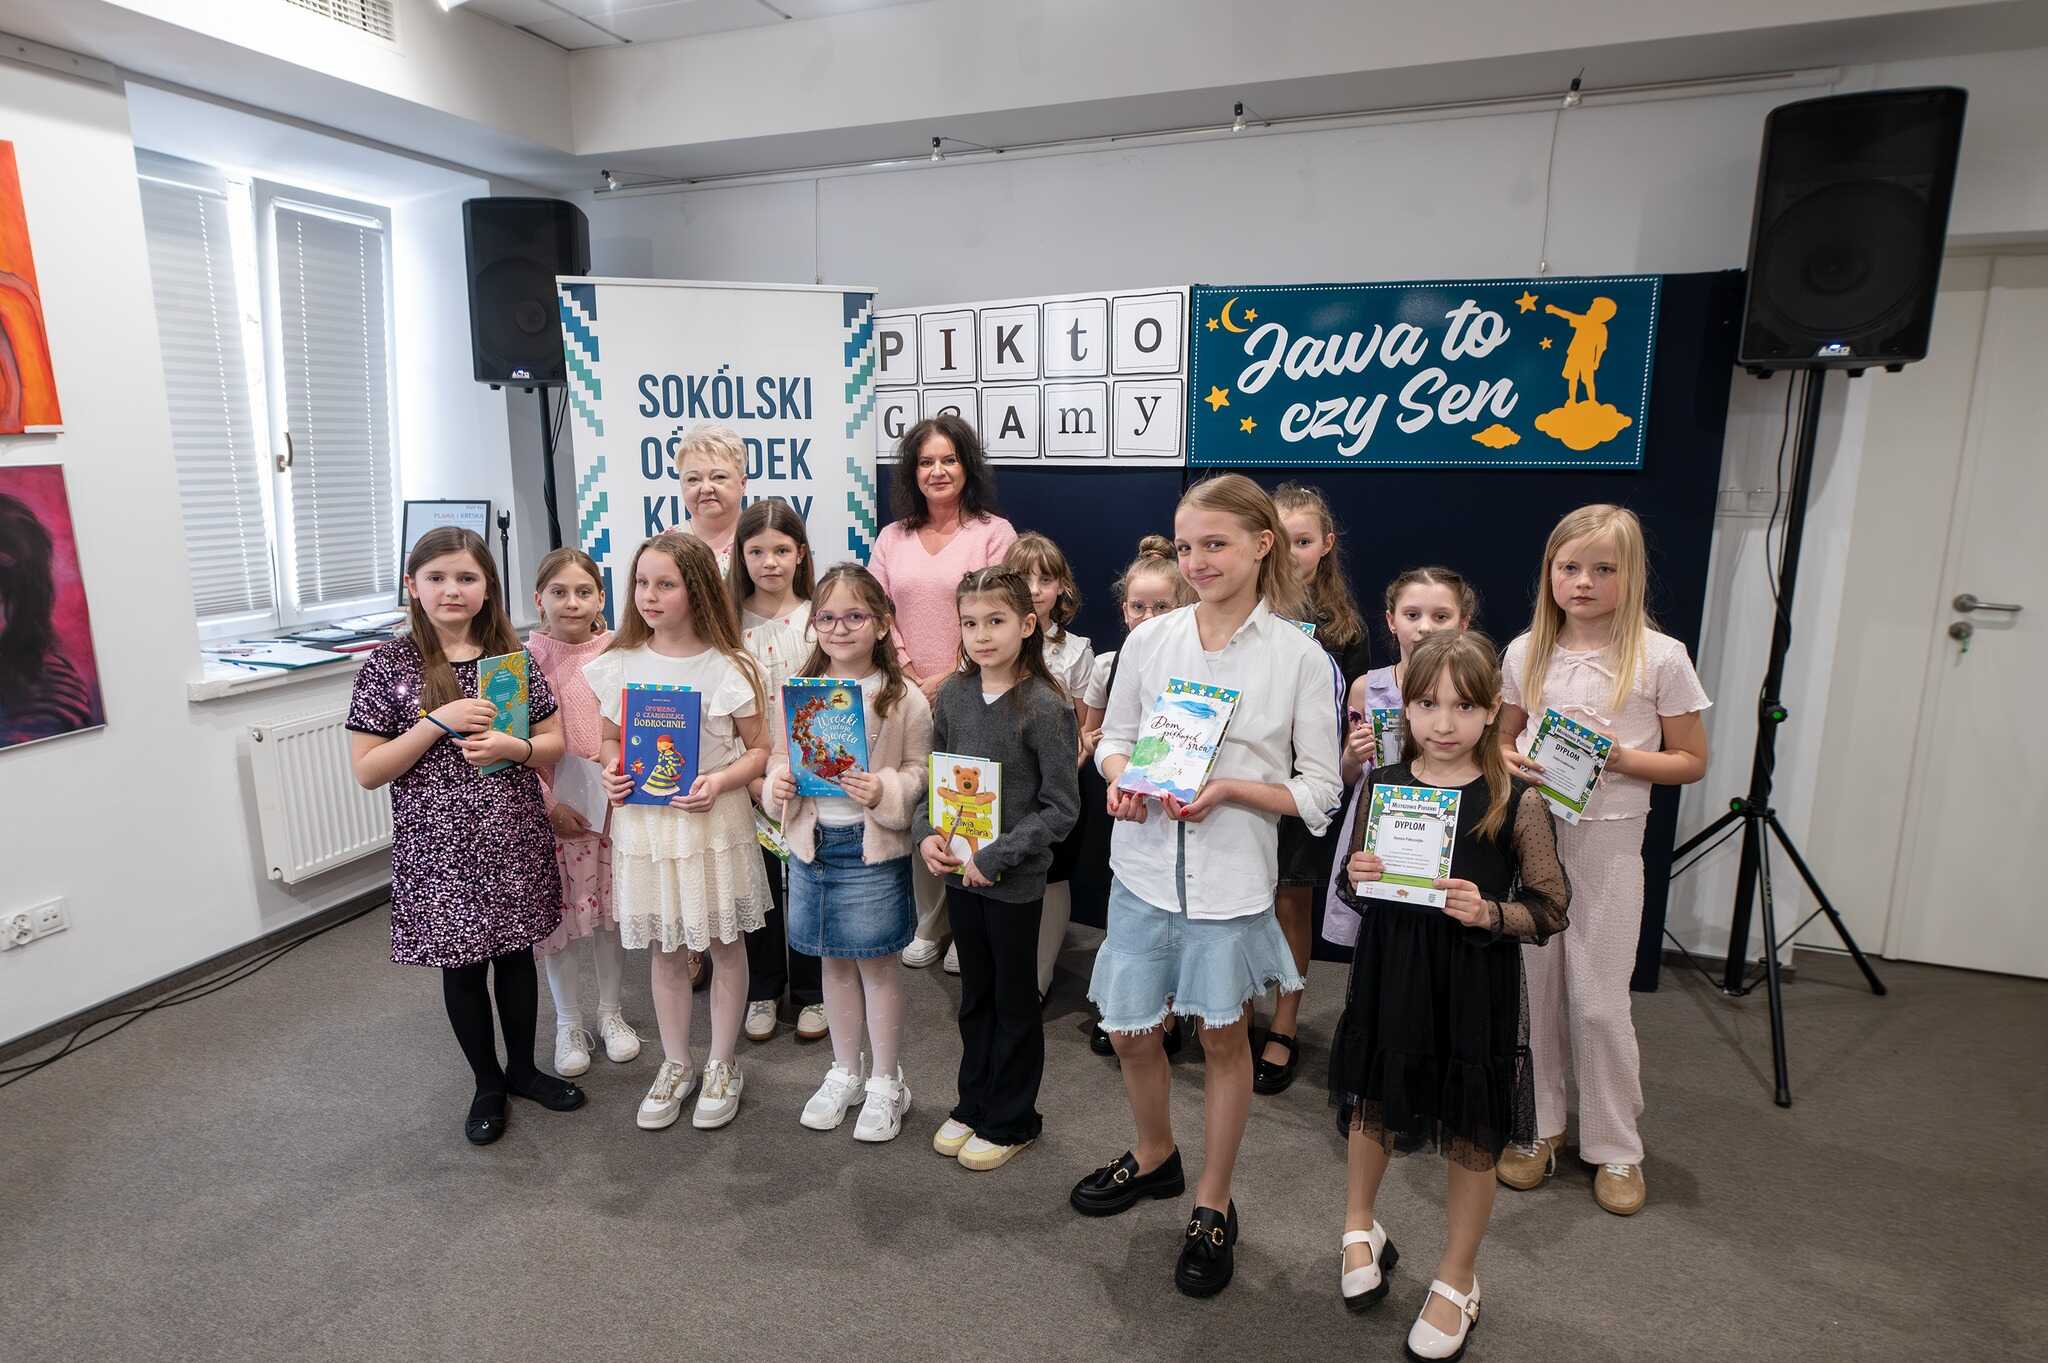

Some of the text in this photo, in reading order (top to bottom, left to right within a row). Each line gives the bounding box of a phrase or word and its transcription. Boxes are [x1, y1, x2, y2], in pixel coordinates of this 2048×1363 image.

[1237, 299, 1511, 394] Jawa to
[638, 364, 812, 420] SOKÓLSKI
[1279, 367, 1519, 457] czy Sen
[640, 426, 813, 481] OŚDEK
[1151, 715, 1180, 730] Dom
[1555, 743, 1580, 762] DYPLOM
[1394, 820, 1426, 831] DYPLOM
